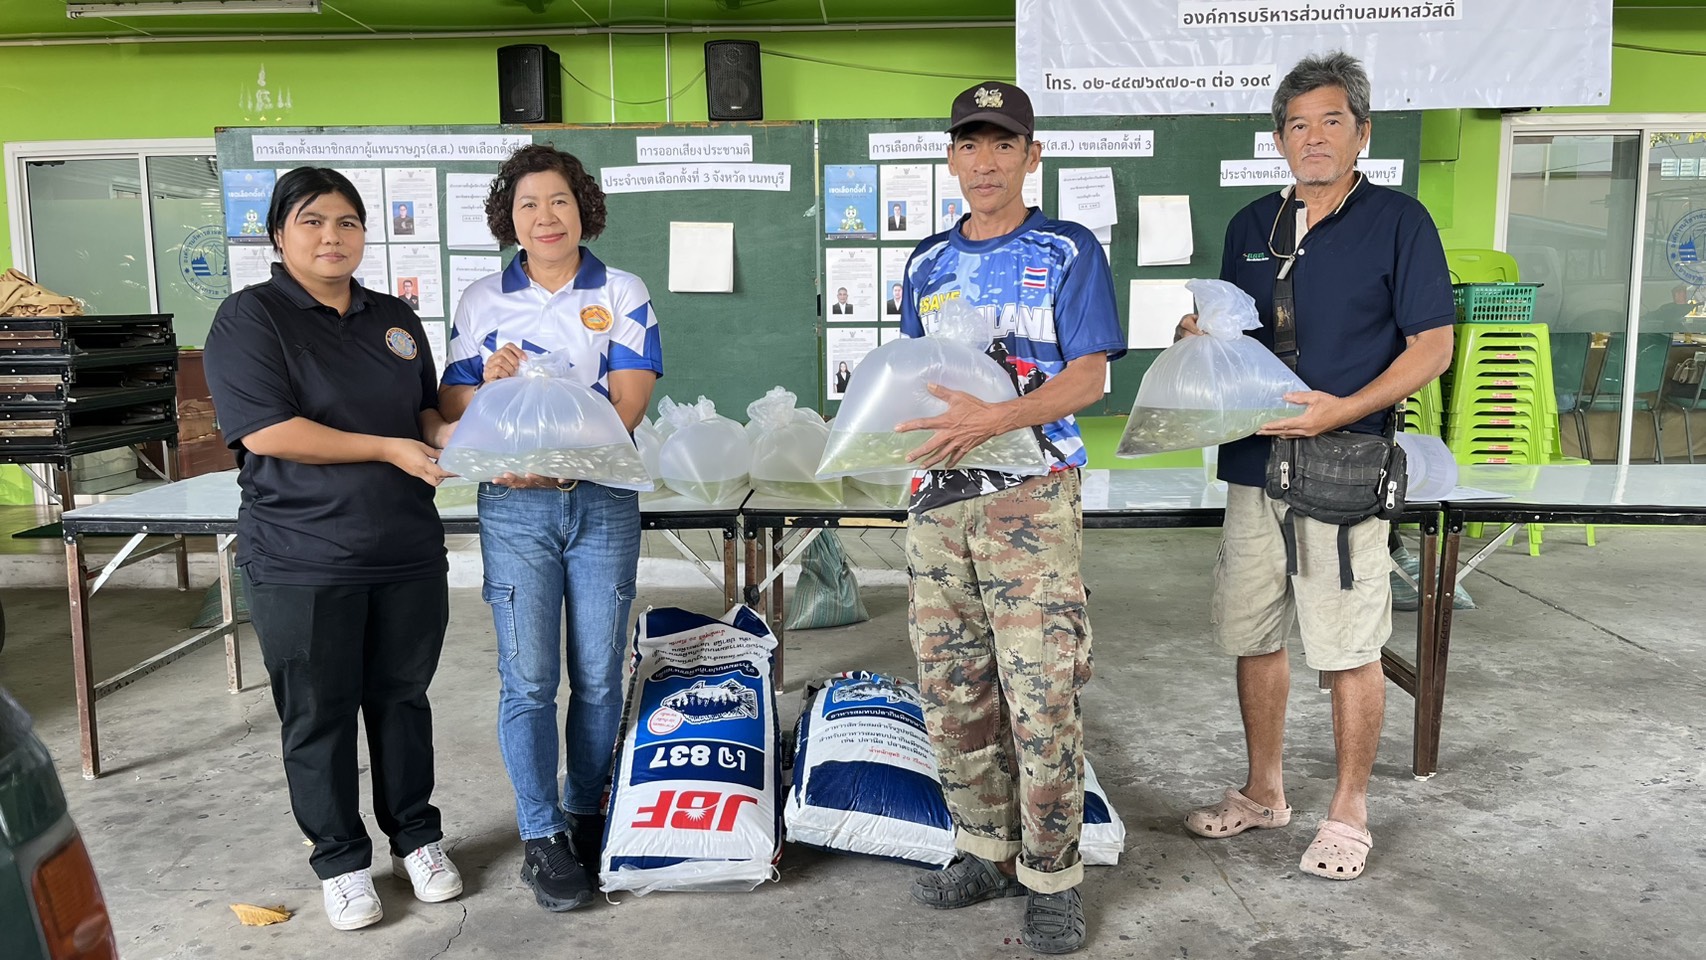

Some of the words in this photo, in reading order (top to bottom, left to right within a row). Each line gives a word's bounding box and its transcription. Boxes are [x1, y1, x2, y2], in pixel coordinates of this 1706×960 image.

[1045, 73, 1077, 90] โทร.
[1082, 76, 1207, 89] ๐๒-๔๔๗๖๙๗๐-๓
[1212, 71, 1235, 87] ต่อ
[1240, 74, 1271, 87] ๑๐๙
[256, 138, 454, 158] การเลือกตั้งสมาชิกสภาผู้แทนราษฎร(ส.ส.)
[872, 135, 948, 154] การเลือกตั้งสมา
[1040, 139, 1075, 152] ร(ส.ส.)
[1078, 134, 1142, 151] เขตเลือกตั้งที่
[1145, 140, 1152, 150] 3
[1257, 141, 1276, 152] การ
[703, 173, 711, 183] 3
[748, 171, 786, 188] นนทบุรี
[1221, 166, 1294, 180] ประจำเขตเลือก
[1364, 166, 1397, 183] นทบุรี
[649, 745, 711, 769] 837
[718, 746, 746, 772] เจ
[631, 789, 758, 832] JBF
